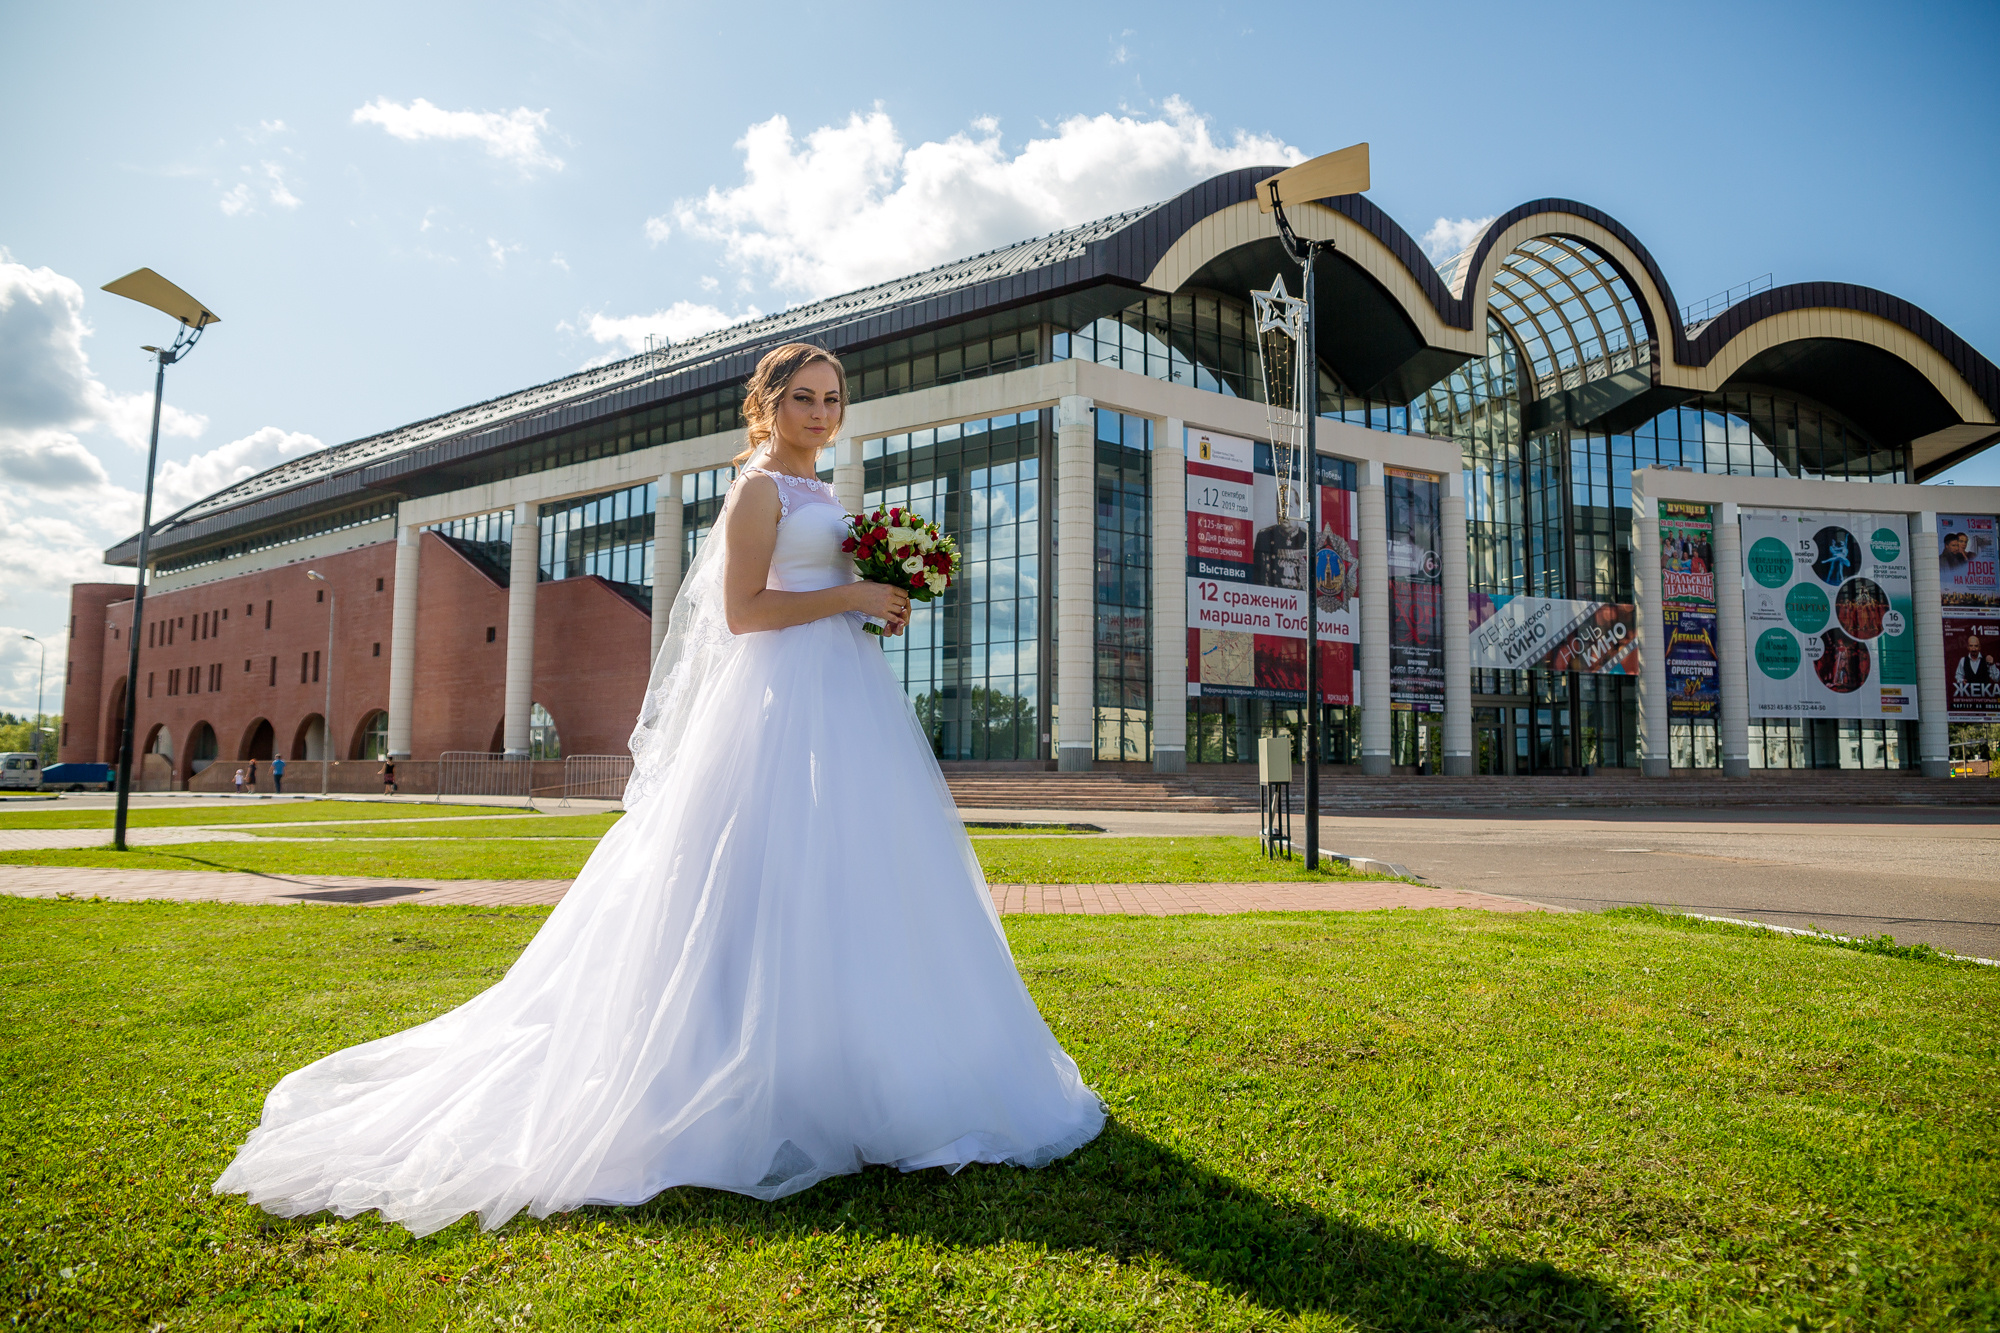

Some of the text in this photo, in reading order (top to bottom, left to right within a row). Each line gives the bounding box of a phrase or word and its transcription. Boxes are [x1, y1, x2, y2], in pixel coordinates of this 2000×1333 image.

[1203, 486, 1220, 508] 12
[1221, 490, 1246, 501] сентября
[1221, 500, 1249, 513] 2019 года
[1203, 519, 1234, 532] 125-летию
[1966, 518, 1976, 529] 13
[1217, 535, 1246, 546] рождения
[1799, 540, 1811, 550] 15
[1197, 545, 1243, 558] нашего земляка
[1198, 561, 1246, 578] Выставка
[1425, 557, 1439, 571] 6+
[1755, 564, 1787, 575] ОЗЕРО
[1967, 561, 1996, 576] ДВОЕ
[1664, 572, 1713, 586] УРАЛЬСКИЕ
[1954, 575, 1996, 586] НА КАЧЕЛЯХ
[1198, 581, 1298, 611] 12 сражений
[1664, 584, 1714, 600] ПЕЛЬМЕНИ
[1785, 602, 1829, 613] СПАРТАК
[1200, 608, 1350, 636] маршала Толбхина
[1394, 603, 1436, 634] ХОР
[1664, 611, 1679, 621] 5.11
[1889, 612, 1899, 622] 16
[1478, 616, 1516, 654] ДЕНЬ
[1970, 624, 1984, 636] 11
[1503, 623, 1547, 664] КИНО
[1560, 625, 1603, 665] НОЧЬ
[1582, 622, 1627, 668] КИНО
[1808, 637, 1818, 646] 17
[1671, 659, 1717, 667] СИМФОНИЧЕСКИМ
[1671, 666, 1714, 676] ОРКЕСТРОМ
[1952, 682, 2000, 697] ЖЕКА
[1700, 701, 1711, 711] 20
